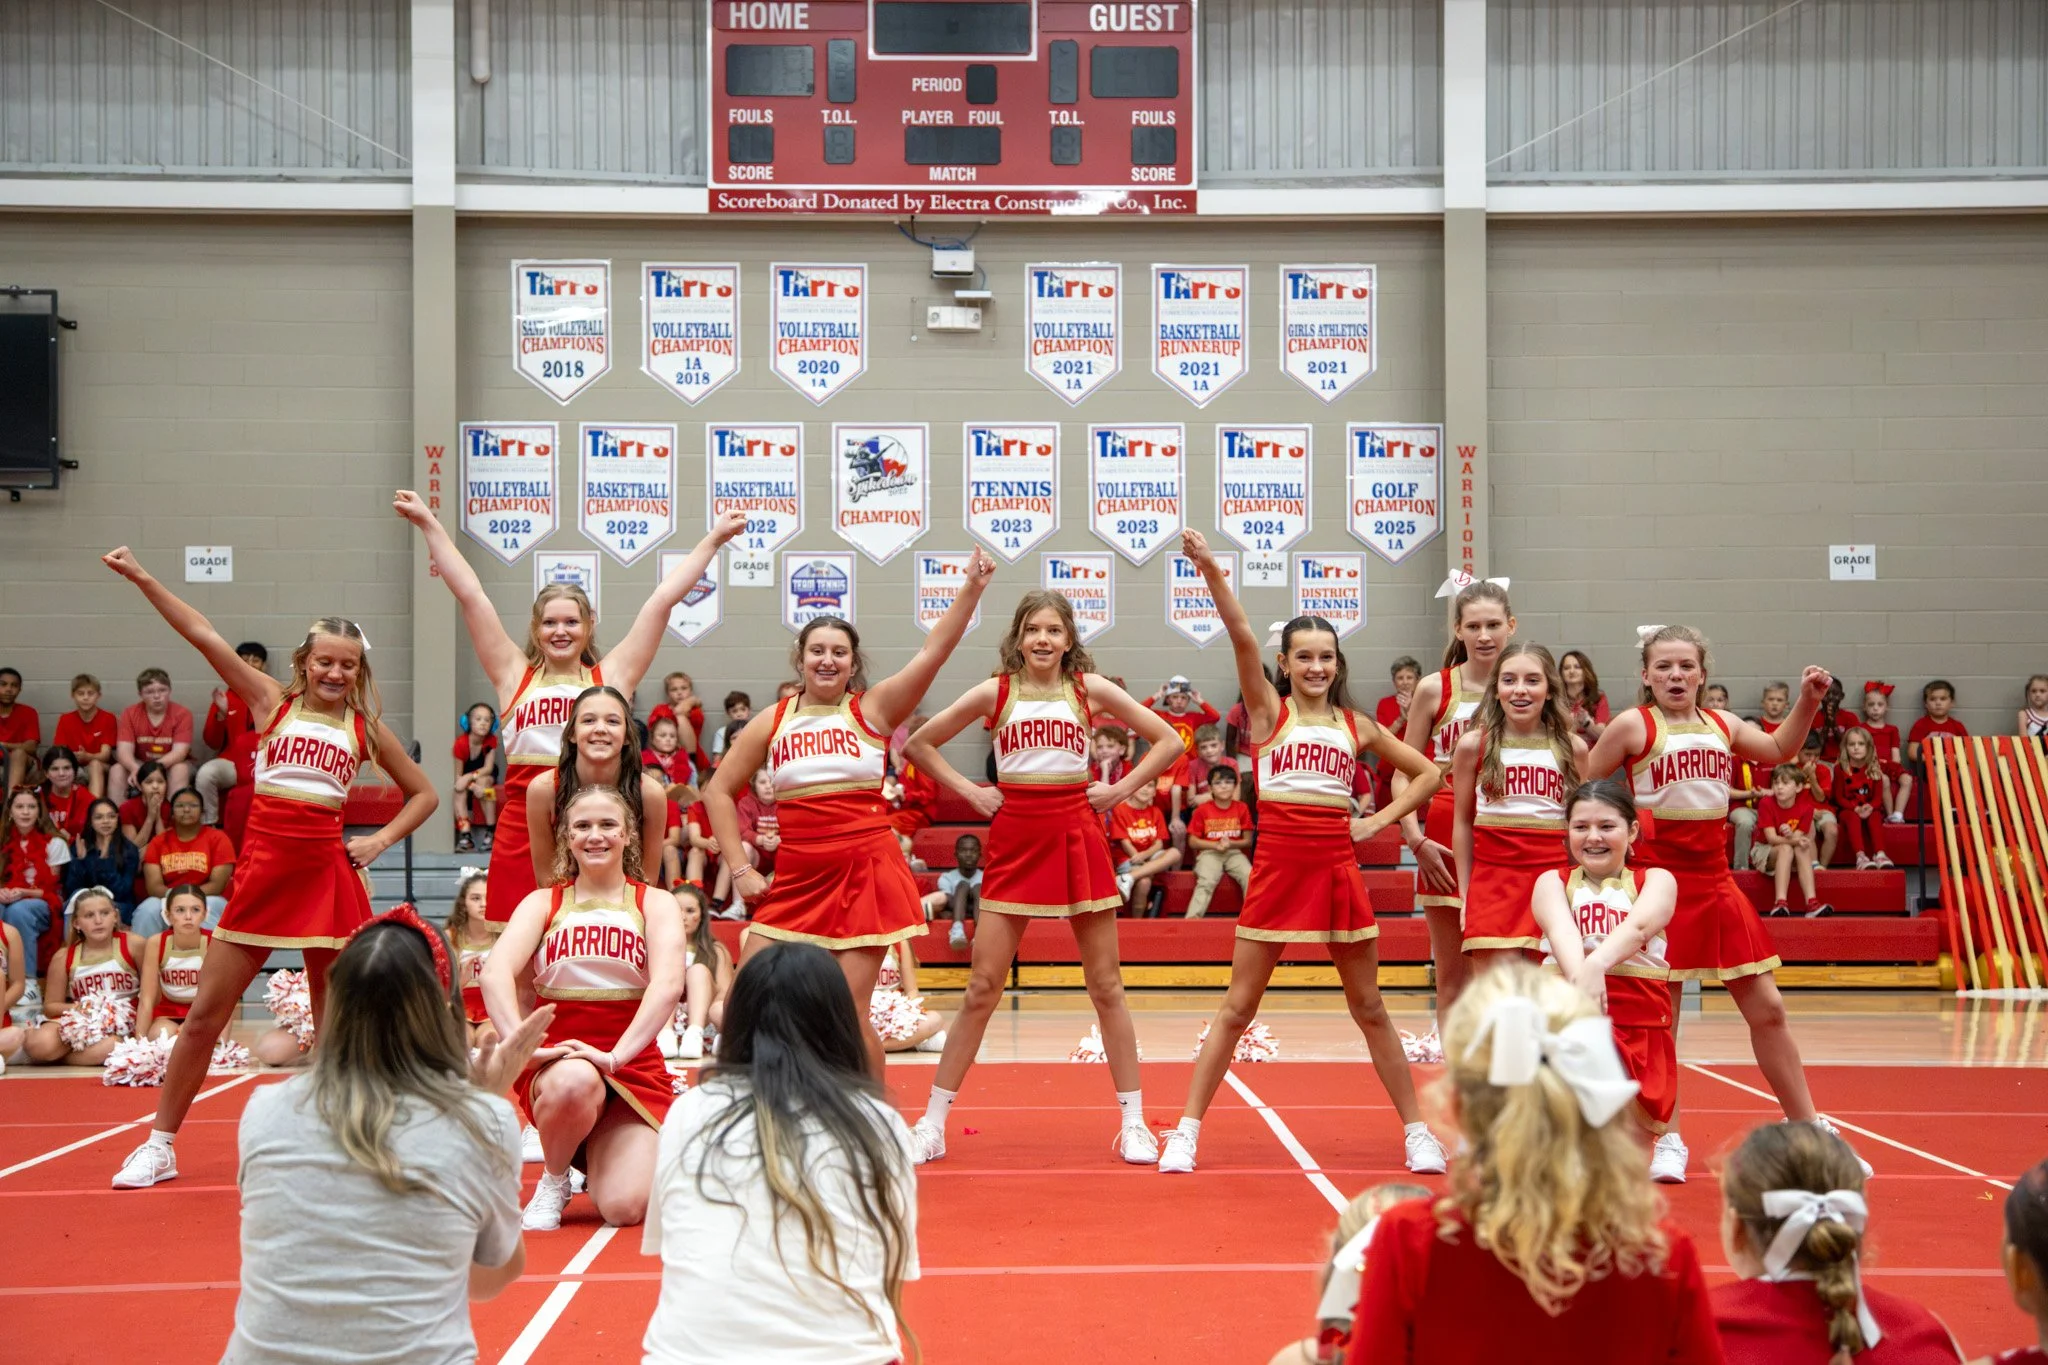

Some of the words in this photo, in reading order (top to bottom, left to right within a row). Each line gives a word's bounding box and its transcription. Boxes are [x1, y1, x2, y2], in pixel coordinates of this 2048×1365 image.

[729, 3, 809, 29] HOME
[1090, 4, 1178, 31] GUEST
[912, 78, 962, 93] PERIOD
[729, 109, 773, 123] FOULS
[822, 110, 857, 124] T.O.L.
[902, 111, 954, 125] PLAYER
[968, 111, 1003, 125] FOUL
[1049, 111, 1085, 125] T.O.L.
[1131, 111, 1176, 125] FOULS
[729, 166, 773, 180] SCORE
[929, 167, 976, 181] MATCH
[1131, 167, 1176, 181] SCORE
[718, 193, 817, 209] Scoreboard
[823, 193, 898, 210] Donated
[904, 193, 925, 213] by
[930, 194, 990, 211] Electra
[1153, 195, 1187, 210] Inc.
[653, 323, 732, 338] VOLLEYBALL
[779, 322, 859, 338] VOLLEYBALL
[1034, 323, 1113, 338] VOLLEYBALL
[1160, 324, 1241, 340] BASKETBALL
[1288, 324, 1315, 338] GIRLS
[1317, 324, 1368, 337] ATHLETICS
[521, 337, 604, 354] CHAMPIONS
[652, 340, 732, 356] CHAMPION
[778, 339, 859, 356] CHAMPION
[1033, 340, 1114, 356] CHAMPION
[1160, 340, 1241, 357] RUNNERUP
[1288, 338, 1368, 353] CHAMPION
[542, 361, 584, 378] 2018
[685, 358, 702, 370] 1A
[798, 360, 840, 374] 2020
[1053, 361, 1093, 375] 2021
[1180, 362, 1220, 376] 2021
[1308, 361, 1347, 374] 2021
[676, 373, 710, 385] 2018
[811, 379, 827, 388] 1A
[1066, 380, 1083, 390] 1A
[1193, 380, 1209, 391] 1A
[1321, 380, 1337, 390] 1A
[469, 481, 551, 497] VOLLEYBALL
[587, 482, 668, 498] BASKETBALL
[715, 482, 796, 497] BASKETBALL
[971, 482, 1051, 497] TENNIS
[1097, 482, 1177, 498] VOLLEYBALL
[1224, 483, 1304, 498] VOLLEYBALL
[1372, 483, 1419, 498] GOLF
[468, 498, 551, 516] CHAMPION
[587, 499, 669, 517] CHAMPIONS
[715, 498, 796, 515] CHAMPIONS
[971, 498, 1051, 515] CHAMPION
[1097, 499, 1177, 515] CHAMPION
[1224, 499, 1304, 516] CHAMPION
[1355, 499, 1435, 516] CHAMPION
[841, 510, 920, 527] CHAMPION
[991, 519, 1032, 532] 2023
[489, 520, 531, 534] 2022
[606, 521, 648, 534] 2022
[746, 520, 776, 534] 022
[1117, 520, 1158, 533] 2023
[1243, 521, 1285, 534] 2024
[1374, 521, 1416, 534] 2025
[503, 538, 519, 549] 1A
[620, 538, 636, 549] 1A
[749, 538, 764, 548] 1A
[1004, 537, 1020, 547] 1A
[1131, 538, 1147, 549] 1A
[1256, 538, 1273, 549] 1A
[1388, 538, 1404, 549] 1A
[189, 557, 228, 566] GRADE
[733, 562, 770, 571] GRADE
[1247, 562, 1284, 571] GRADE
[1833, 556, 1871, 565] GRADE
[205, 567, 213, 576] 4
[747, 572, 755, 580] 3
[1261, 572, 1268, 580] 2
[1850, 565, 1855, 574] 1
[921, 587, 958, 597] DISTRI
[1302, 588, 1358, 597] DISTRICT
[1084, 599, 1106, 609] FIELD
[1174, 598, 1214, 608] TENN
[1302, 599, 1358, 609] TENNIS
[1079, 610, 1106, 621] PLACE
[998, 720, 1085, 758] WARRIORS
[772, 728, 861, 771] WARRIORS
[267, 736, 356, 786] WARRIORS
[1270, 742, 1355, 787] WARRIORS
[1650, 749, 1732, 790] WARRIORS
[1505, 766, 1565, 803] RRIORS
[546, 925, 647, 971] WARRIORS
